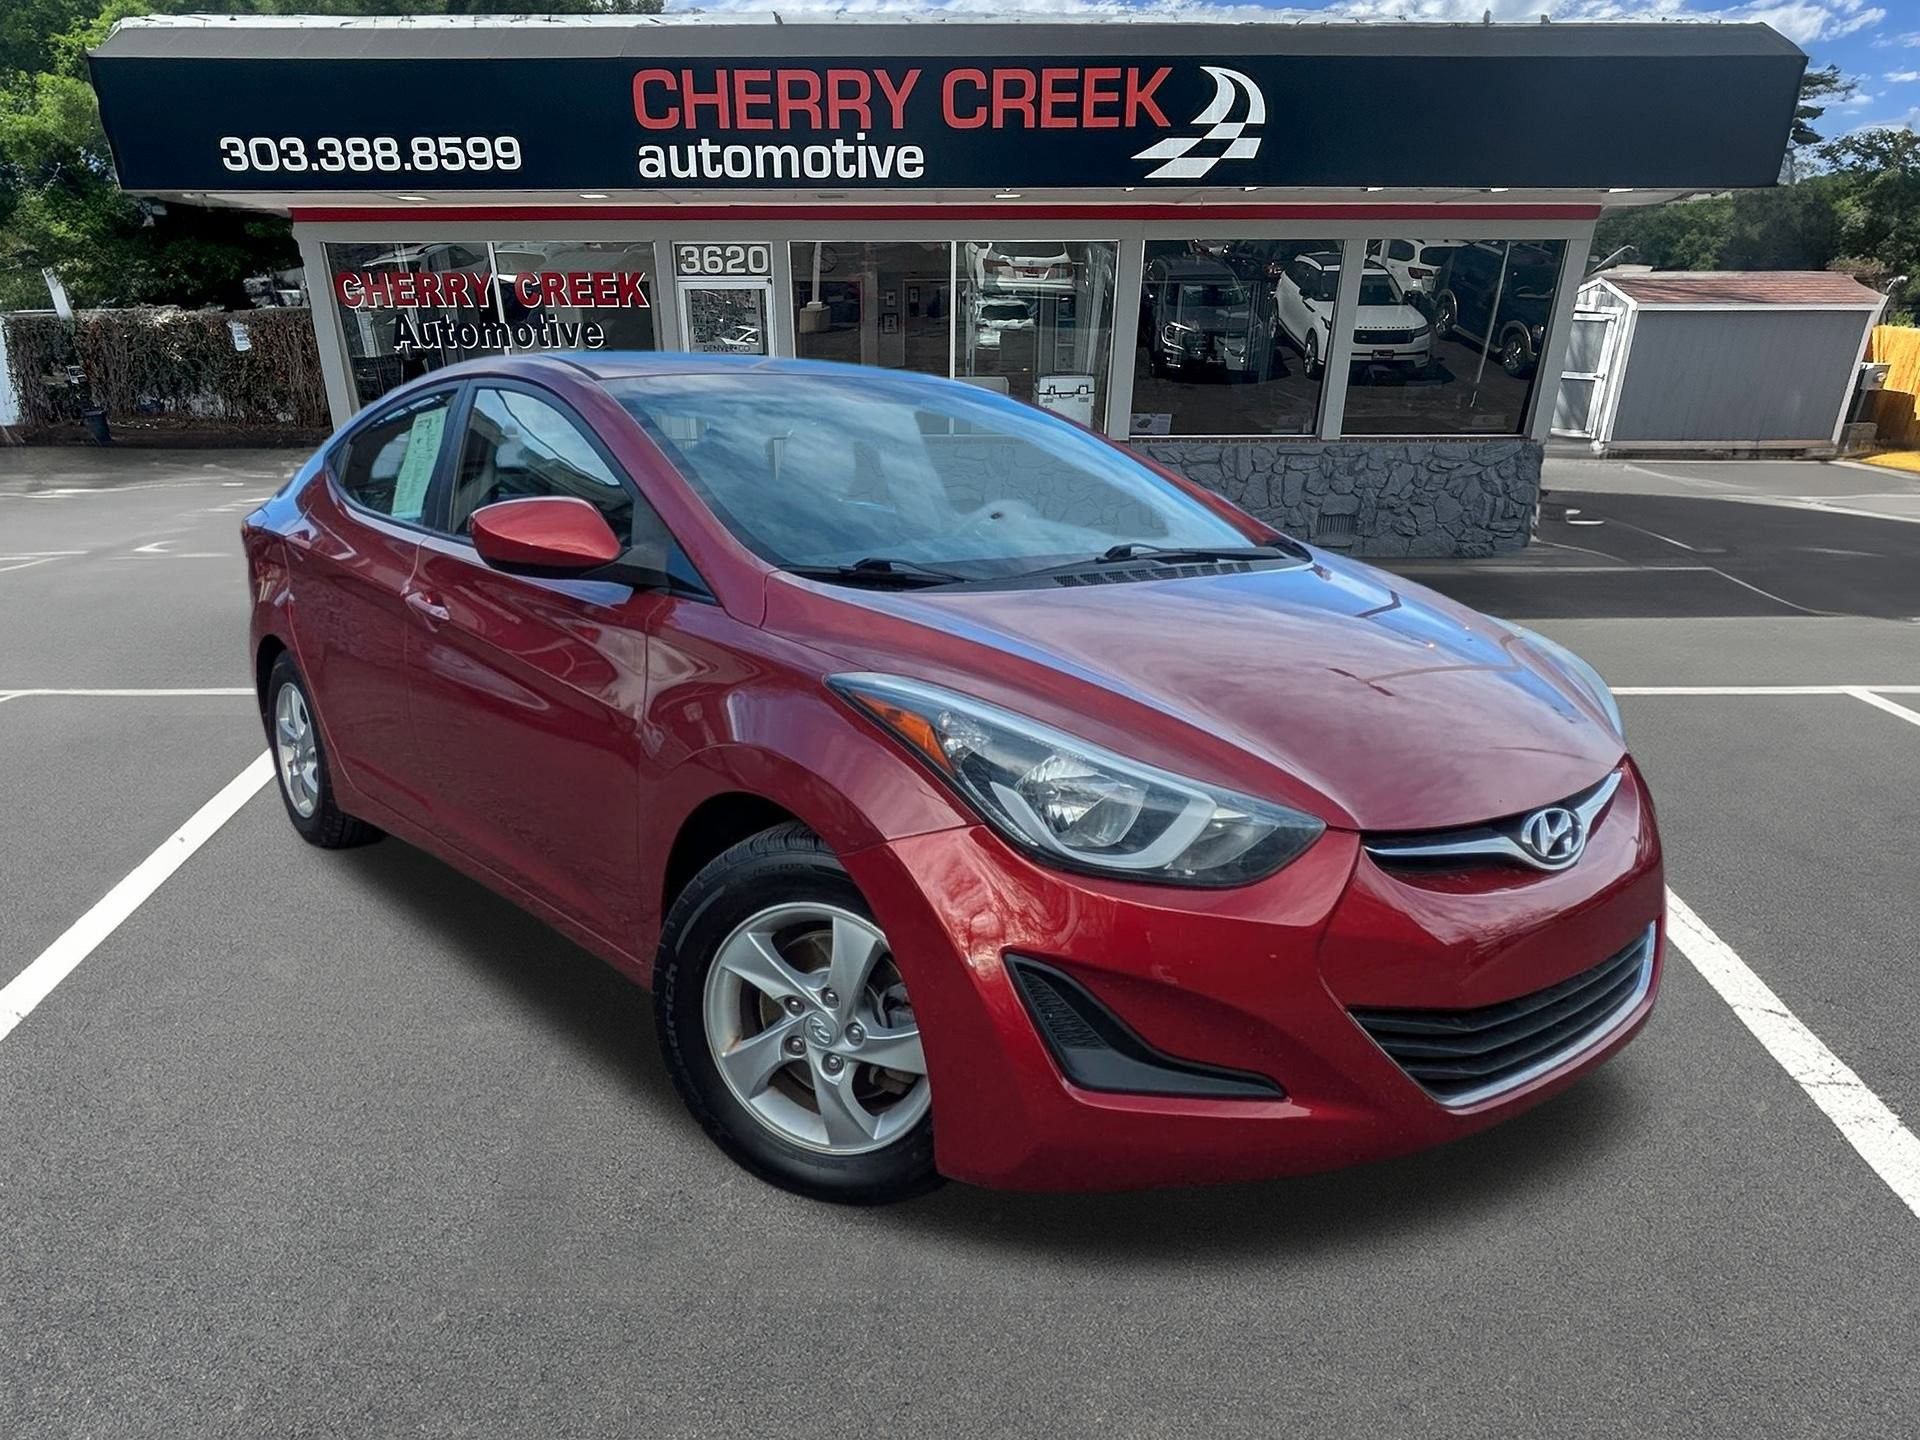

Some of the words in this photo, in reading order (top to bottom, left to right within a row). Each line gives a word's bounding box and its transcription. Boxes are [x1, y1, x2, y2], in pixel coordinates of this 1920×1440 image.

[633, 69, 919, 130] CHERRY
[942, 66, 1172, 129] CREEK
[219, 135, 522, 172] 303.388.8599
[638, 132, 925, 180] automotive
[680, 246, 769, 274] 3620
[334, 271, 493, 309] CHERRY
[514, 271, 650, 309] CREEK
[393, 313, 606, 349] Automotive
